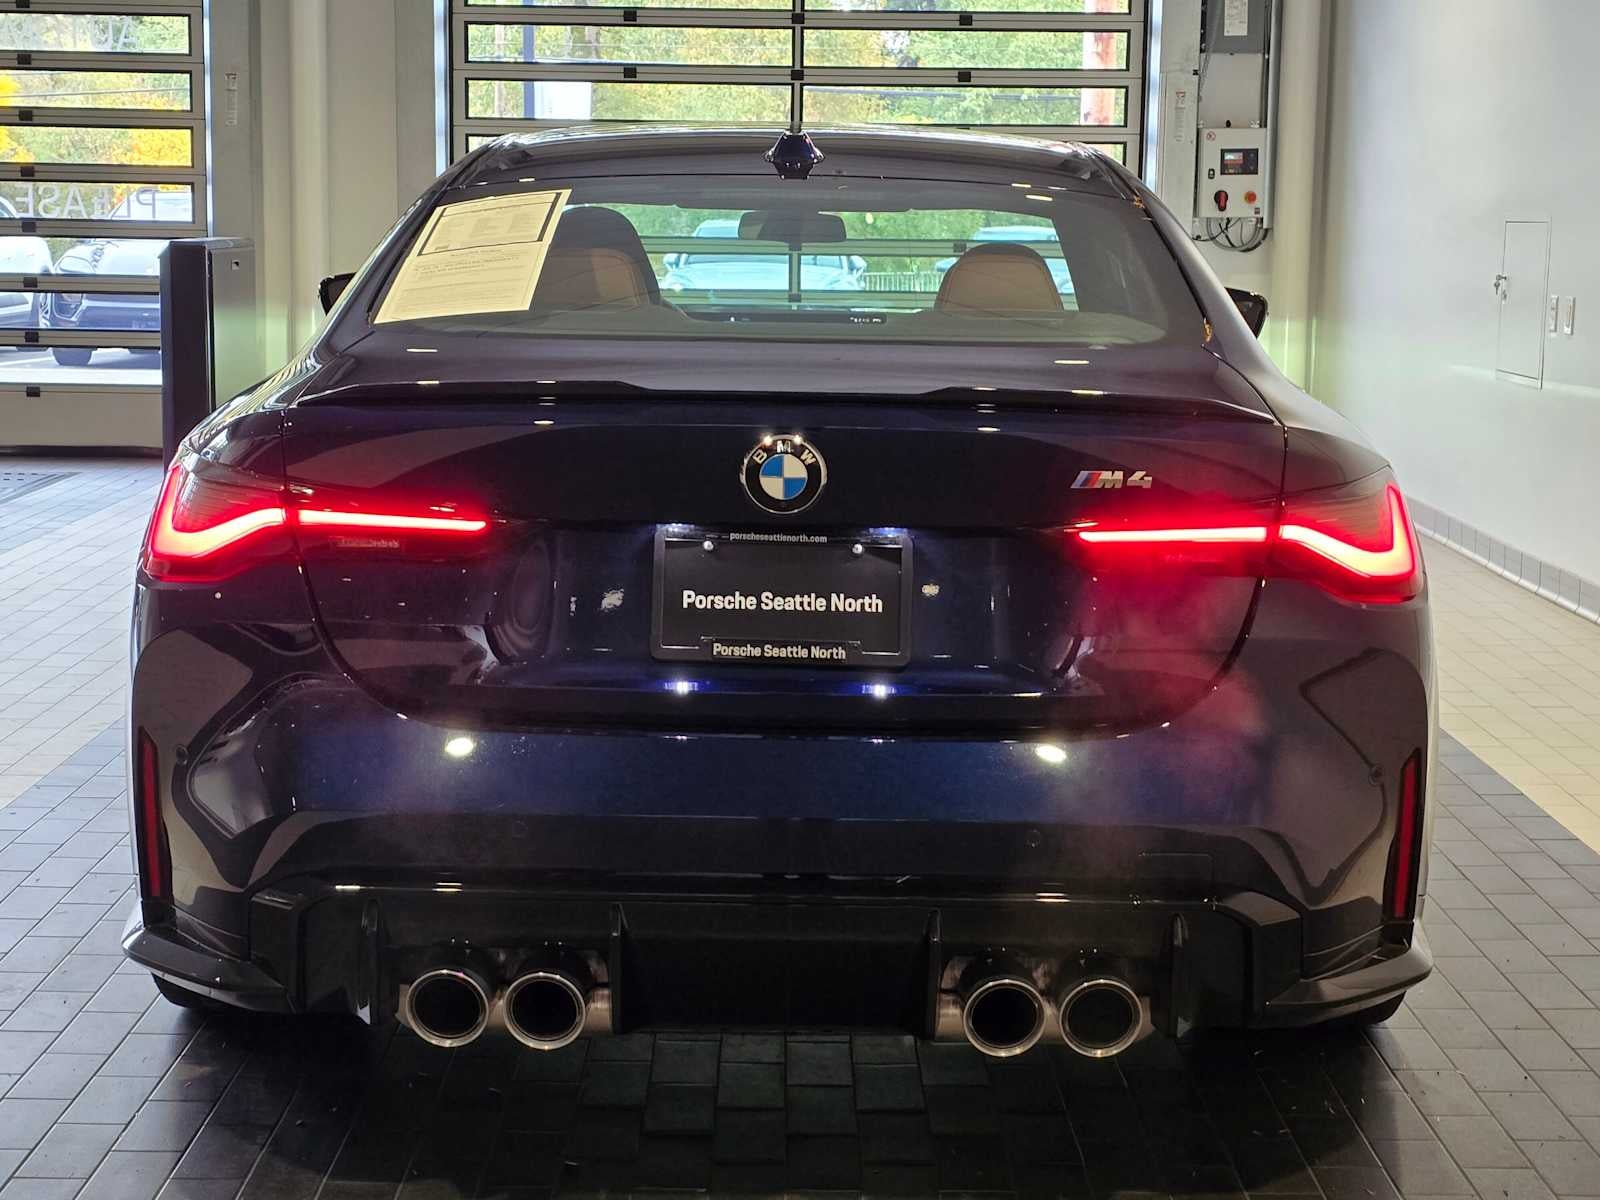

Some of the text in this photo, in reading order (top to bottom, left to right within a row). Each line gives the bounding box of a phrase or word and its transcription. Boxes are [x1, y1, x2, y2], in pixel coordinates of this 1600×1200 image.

[752, 440, 817, 466] BMW
[1097, 470, 1152, 489] M4
[729, 532, 828, 543] porscheseattlenorth.com
[682, 589, 883, 613] Porsche Seattle North
[712, 642, 847, 660] Porsche Seattle North
